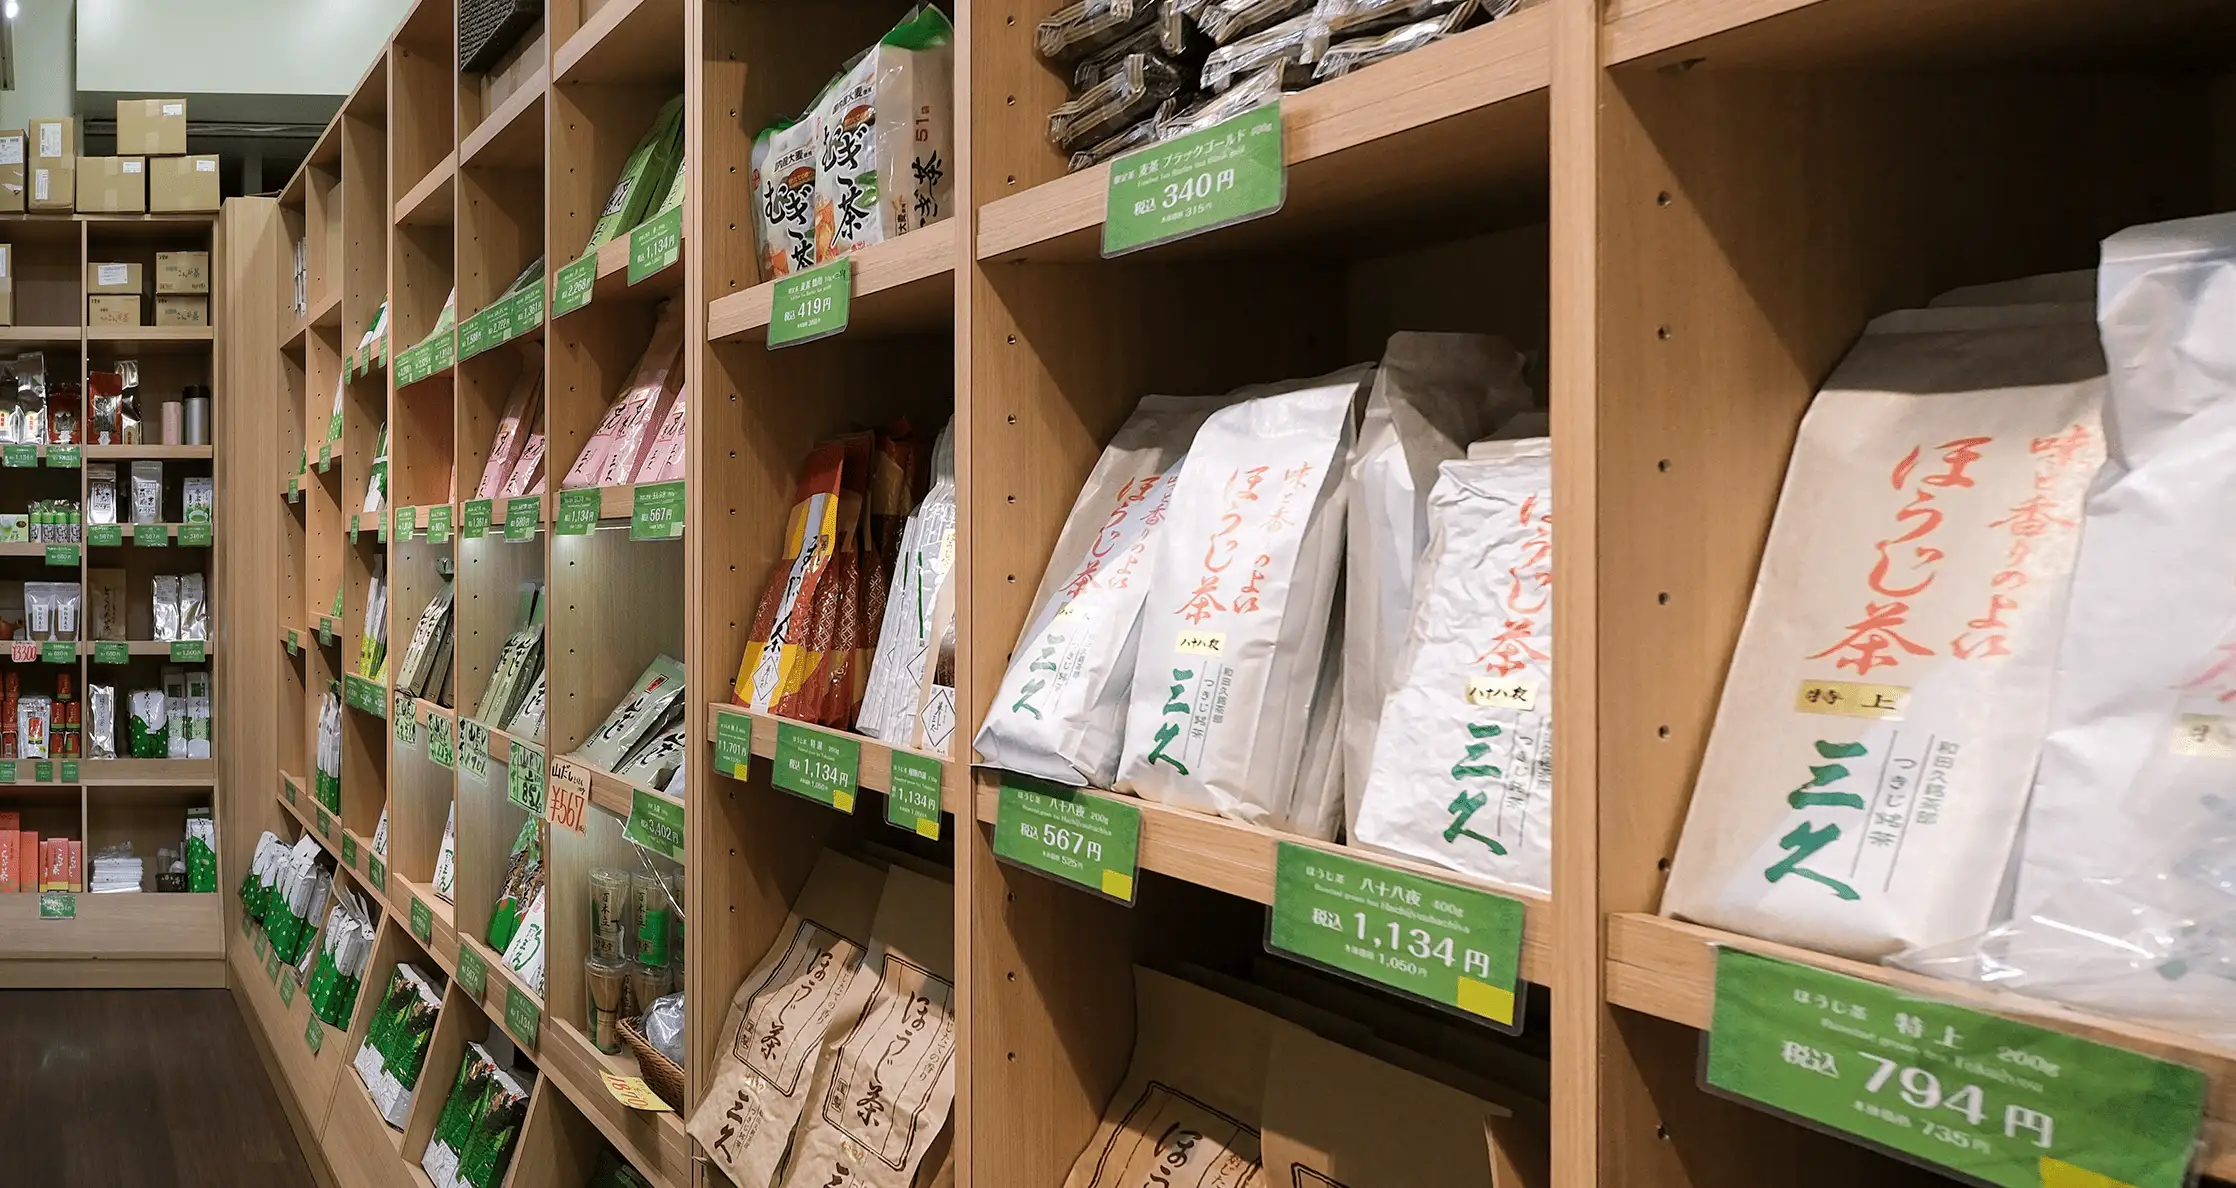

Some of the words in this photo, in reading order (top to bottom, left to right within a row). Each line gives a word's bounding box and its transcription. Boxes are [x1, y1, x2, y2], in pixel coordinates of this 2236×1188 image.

[1162, 127, 1247, 168] ブラックゴールド
[1134, 197, 1157, 216] 税込
[1173, 465, 1270, 626] ほうじ茶
[1805, 436, 1994, 676] ほうじ茶
[1148, 668, 1194, 776] 三久
[804, 758, 849, 788] 1,134円
[898, 787, 936, 811] 1,134円
[1443, 721, 1508, 856] 三久
[550, 785, 586, 831] ¥567
[649, 818, 679, 844] 3,402円
[1049, 798, 1086, 818] 八十八夜
[1763, 739, 1869, 901] 三久
[1020, 822, 1039, 841] 税込
[1042, 823, 1102, 862] 567円
[1305, 865, 1346, 885] ほうじ茶
[1359, 877, 1422, 907] 八十八夜
[1312, 907, 1344, 932] 税込
[1353, 911, 1490, 979] 1,134円
[760, 947, 834, 1061] ほうじ茶
[1793, 988, 1868, 1021] ほうじ茶
[1894, 1012, 1965, 1049] 特上
[856, 990, 930, 1128] ほうじ茶
[1780, 1039, 1840, 1079] 税込
[1857, 1050, 2054, 1149] 794円
